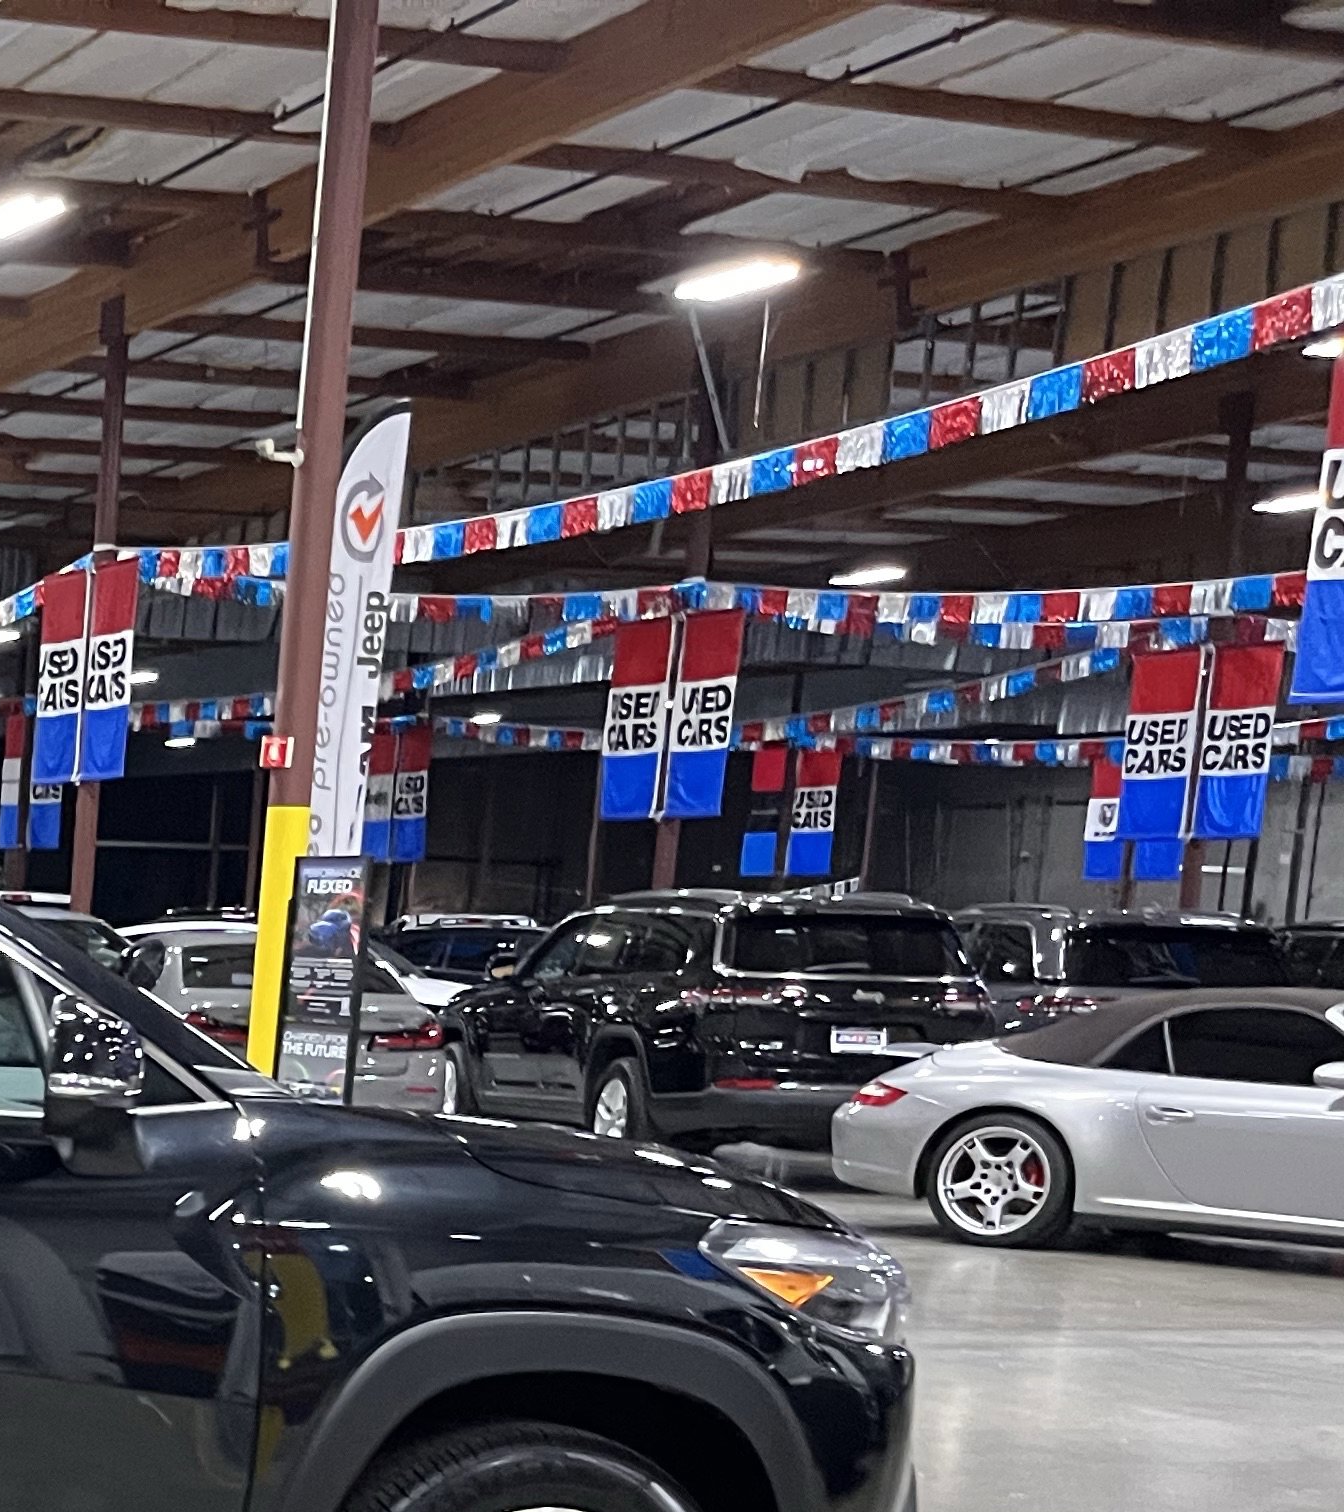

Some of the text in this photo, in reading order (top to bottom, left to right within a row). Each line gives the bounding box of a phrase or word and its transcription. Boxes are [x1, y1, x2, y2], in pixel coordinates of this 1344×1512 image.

[357, 590, 388, 680] Jeep
[39, 679, 80, 712] AS
[87, 670, 126, 704] CAS
[682, 685, 732, 715] UED
[1127, 718, 1189, 746] USED
[1207, 713, 1271, 741] USED
[1125, 747, 1187, 774] CARS
[1202, 743, 1267, 770] CARS
[307, 879, 353, 894] FLEXED
[282, 1041, 347, 1060] THE FUTURE
